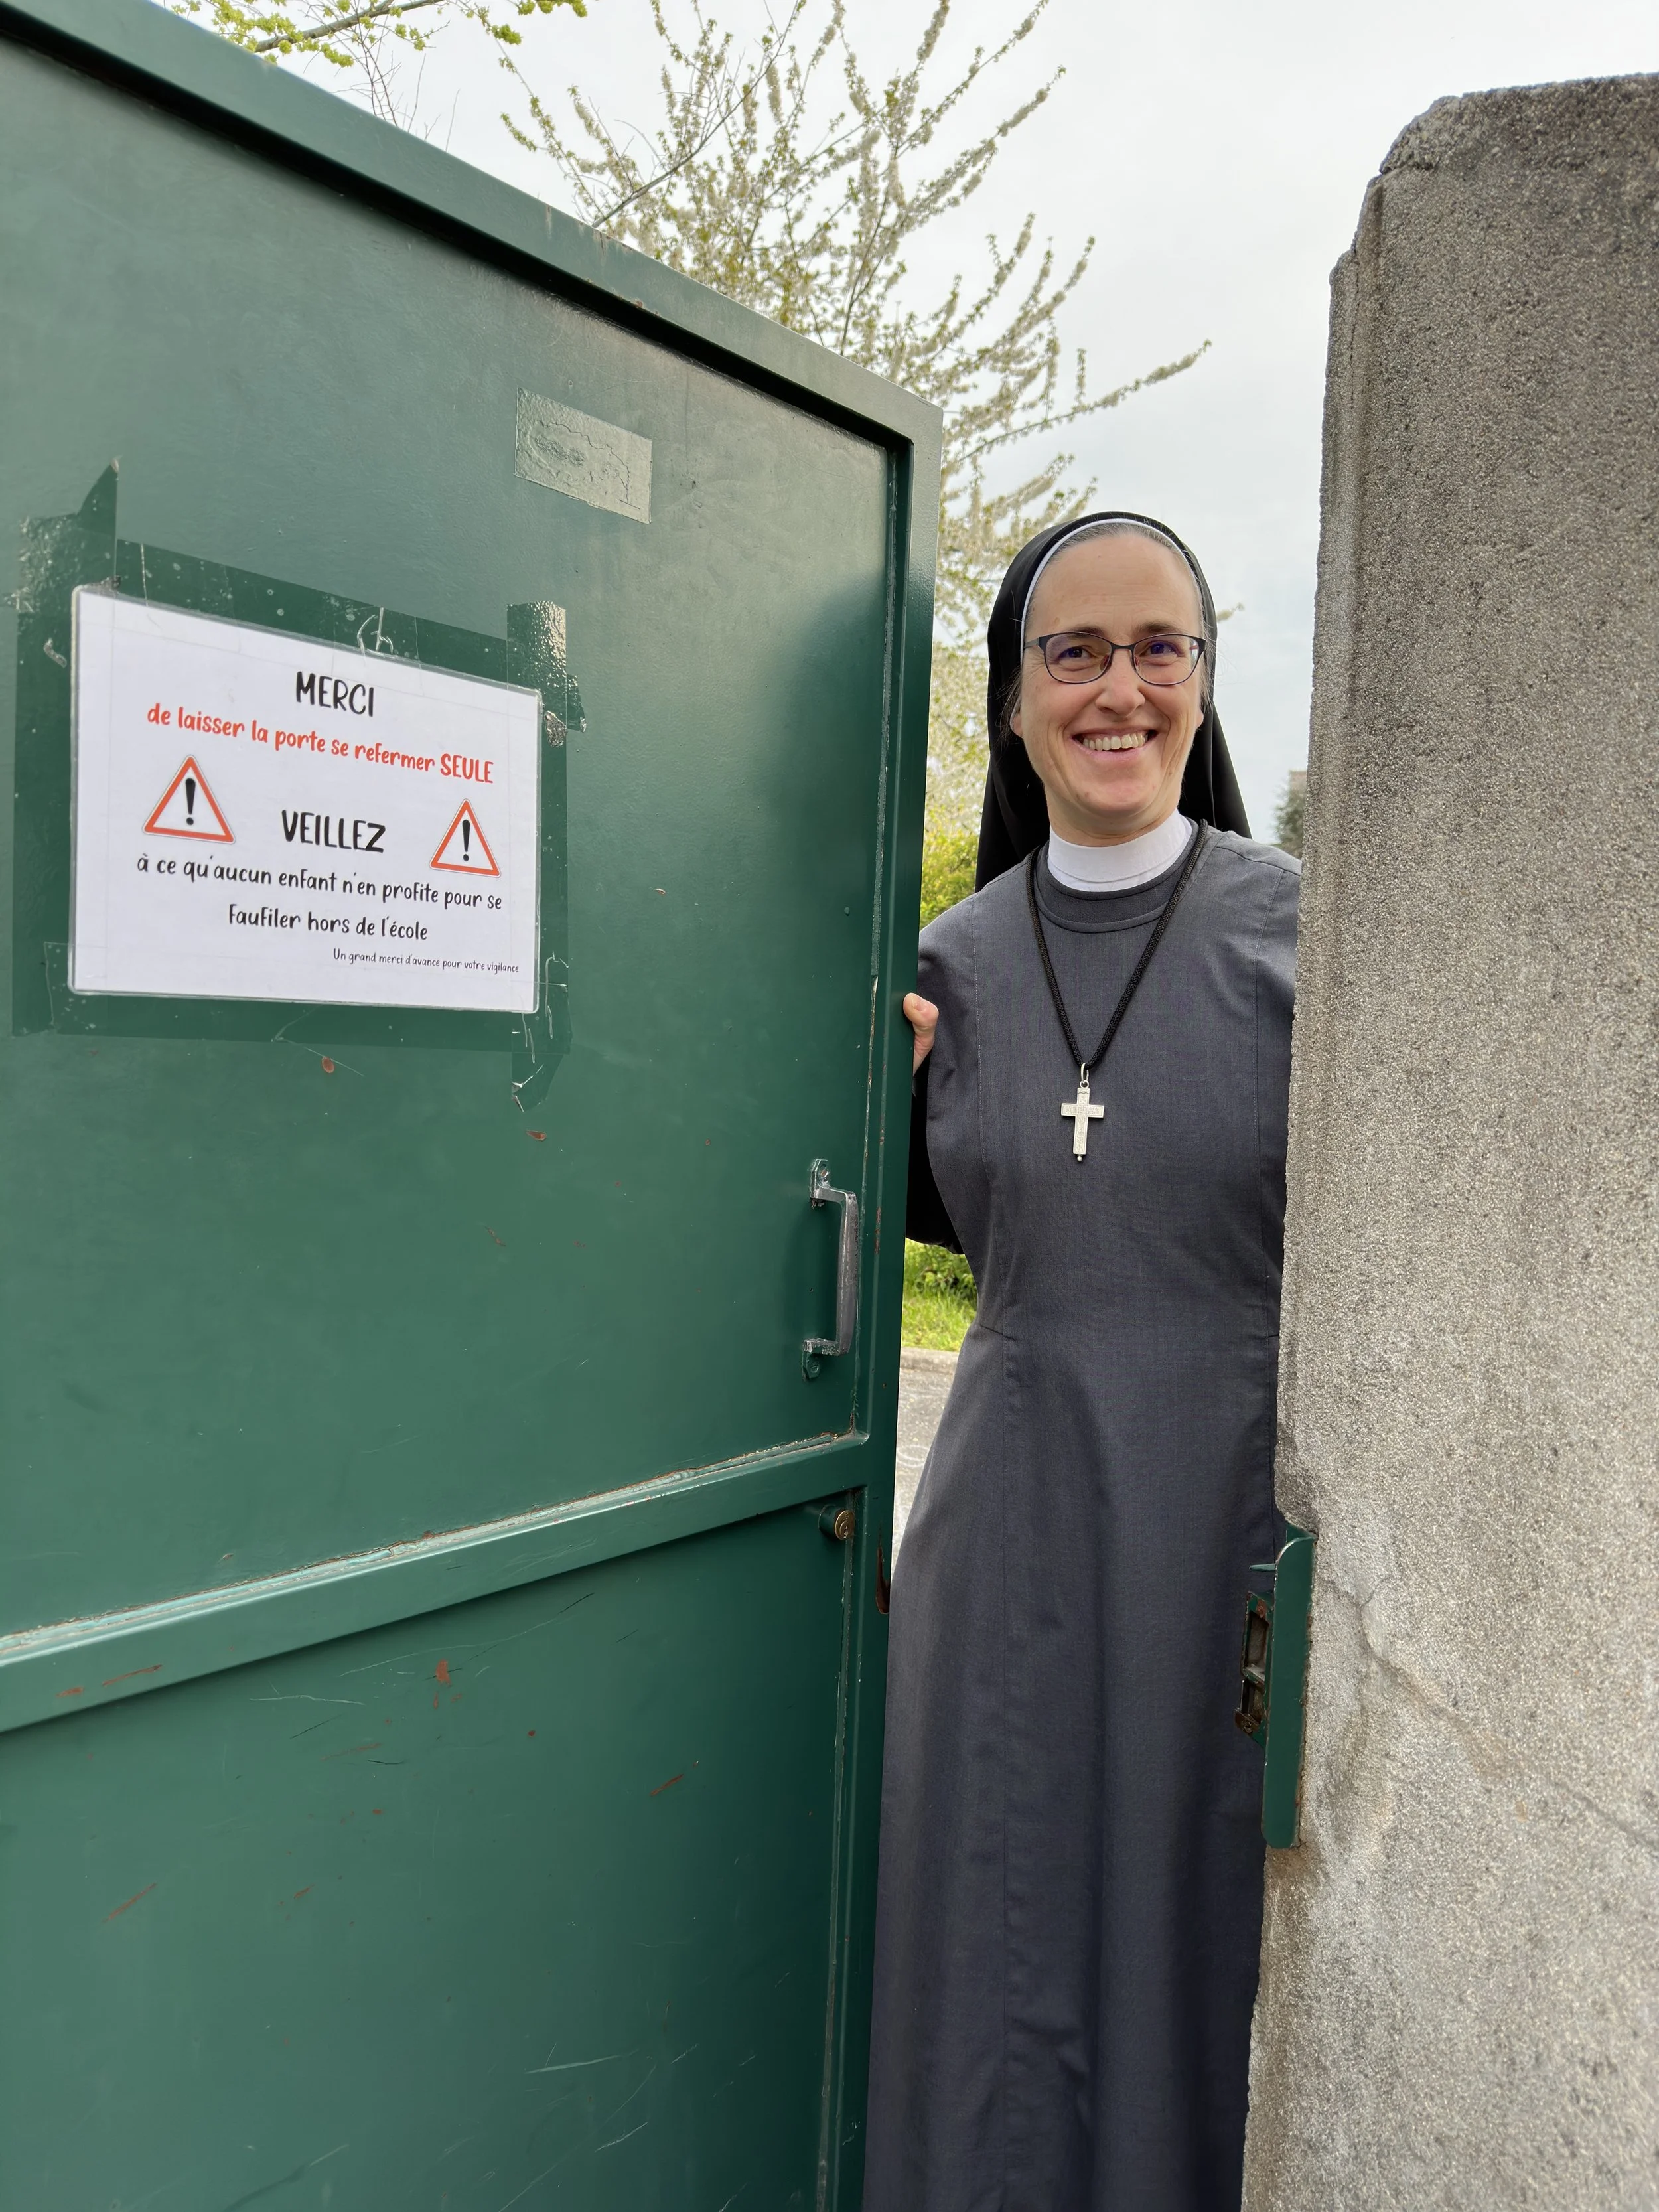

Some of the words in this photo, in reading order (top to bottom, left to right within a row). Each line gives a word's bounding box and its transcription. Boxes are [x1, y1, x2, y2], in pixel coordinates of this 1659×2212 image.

[295, 671, 374, 717] MERCI
[147, 703, 171, 725] de
[177, 706, 245, 738] laisser
[252, 719, 269, 743] la
[275, 730, 326, 753] porte
[330, 739, 349, 757] se
[354, 743, 435, 772] refermer
[440, 753, 494, 784] SEULE
[281, 809, 386, 854] VEILLEZ
[137, 853, 149, 873] à
[156, 859, 177, 875] ce
[183, 855, 272, 885] qu'aucun
[278, 868, 338, 892] enfant
[342, 871, 376, 896] n'en
[382, 881, 439, 903] profite
[444, 891, 482, 910] pour
[487, 895, 502, 910] se
[307, 911, 350, 934] hors
[356, 916, 375, 936] de
[381, 915, 428, 940] l'école
[333, 948, 346, 960] Un
[348, 952, 376, 965] grand
[379, 956, 403, 964] merci
[405, 955, 440, 967] d'avance
[442, 960, 462, 970] pour
[464, 960, 485, 970] votre
[487, 962, 519, 975] vigilance
